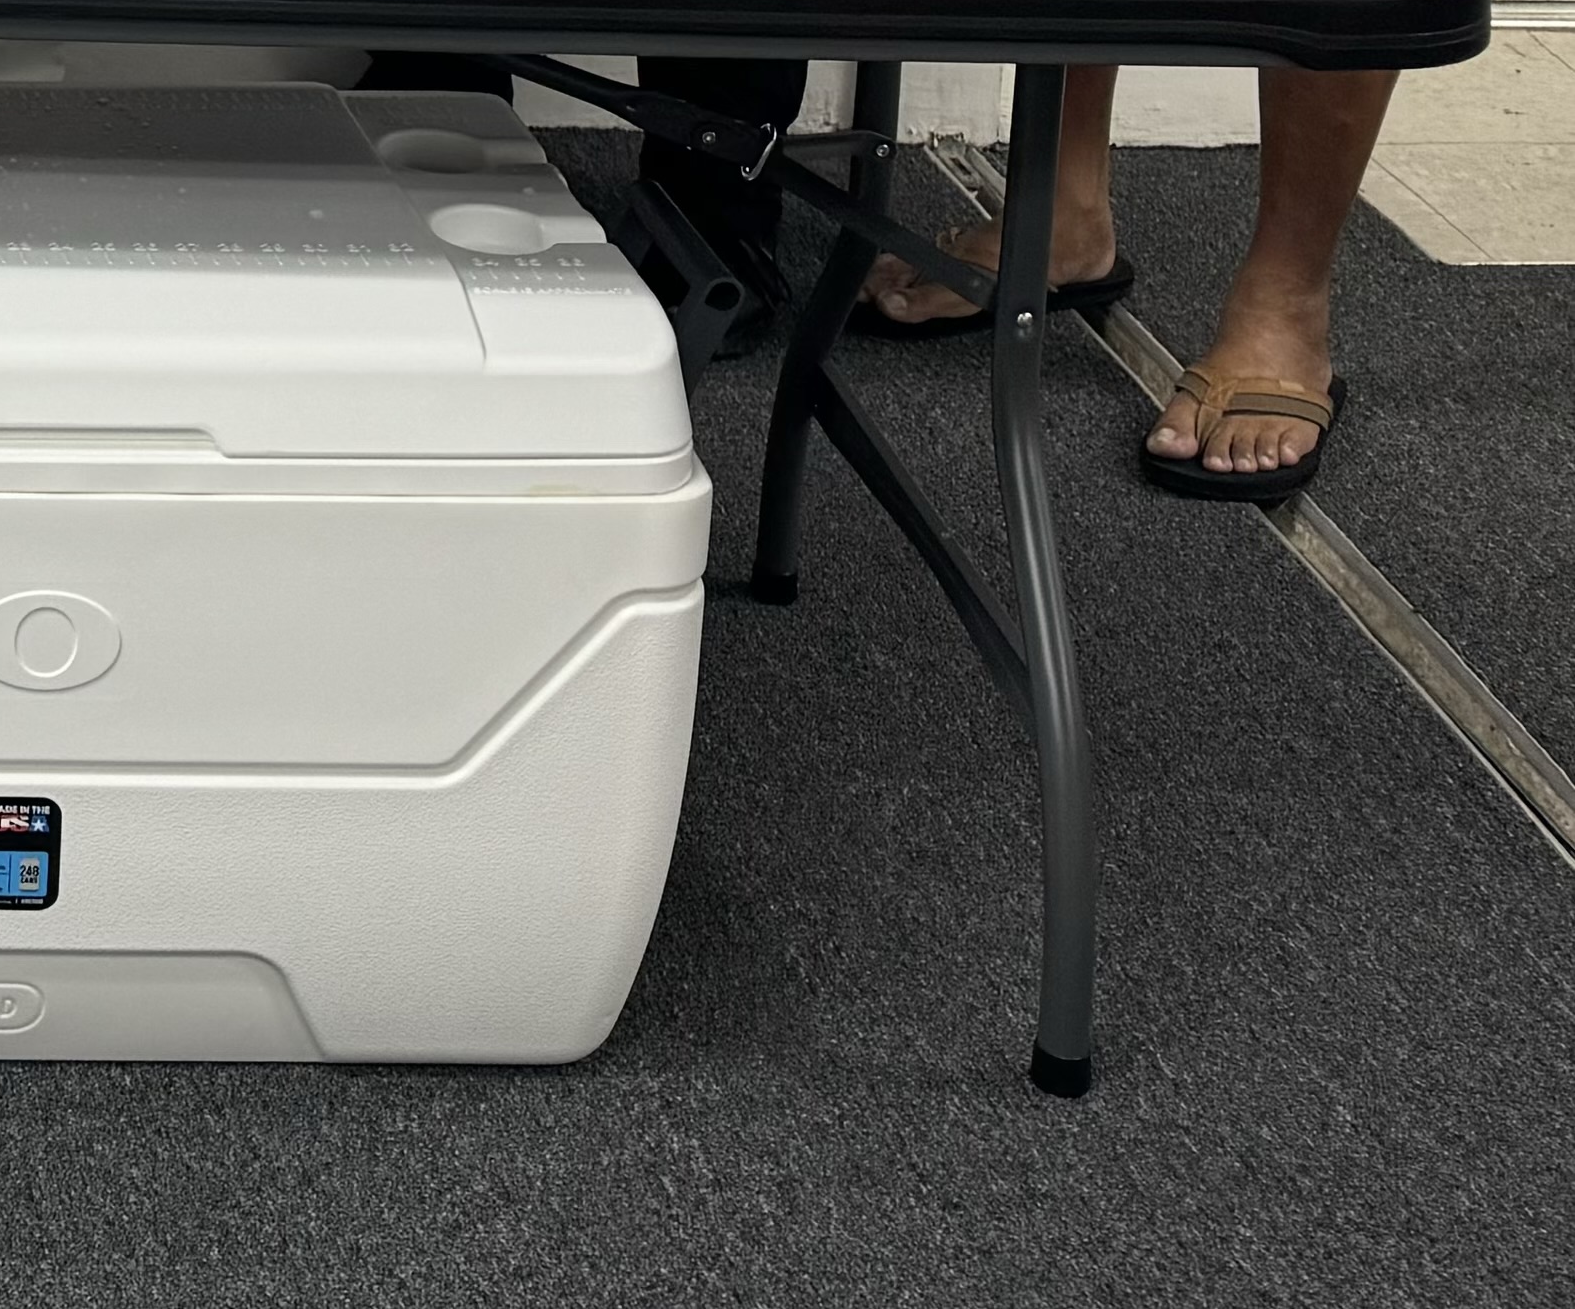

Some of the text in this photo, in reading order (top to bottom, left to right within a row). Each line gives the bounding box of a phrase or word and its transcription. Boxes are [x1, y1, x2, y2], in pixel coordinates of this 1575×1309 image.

[20, 805, 30, 814] IN
[32, 806, 50, 815] THE
[19, 865, 40, 877] 248
